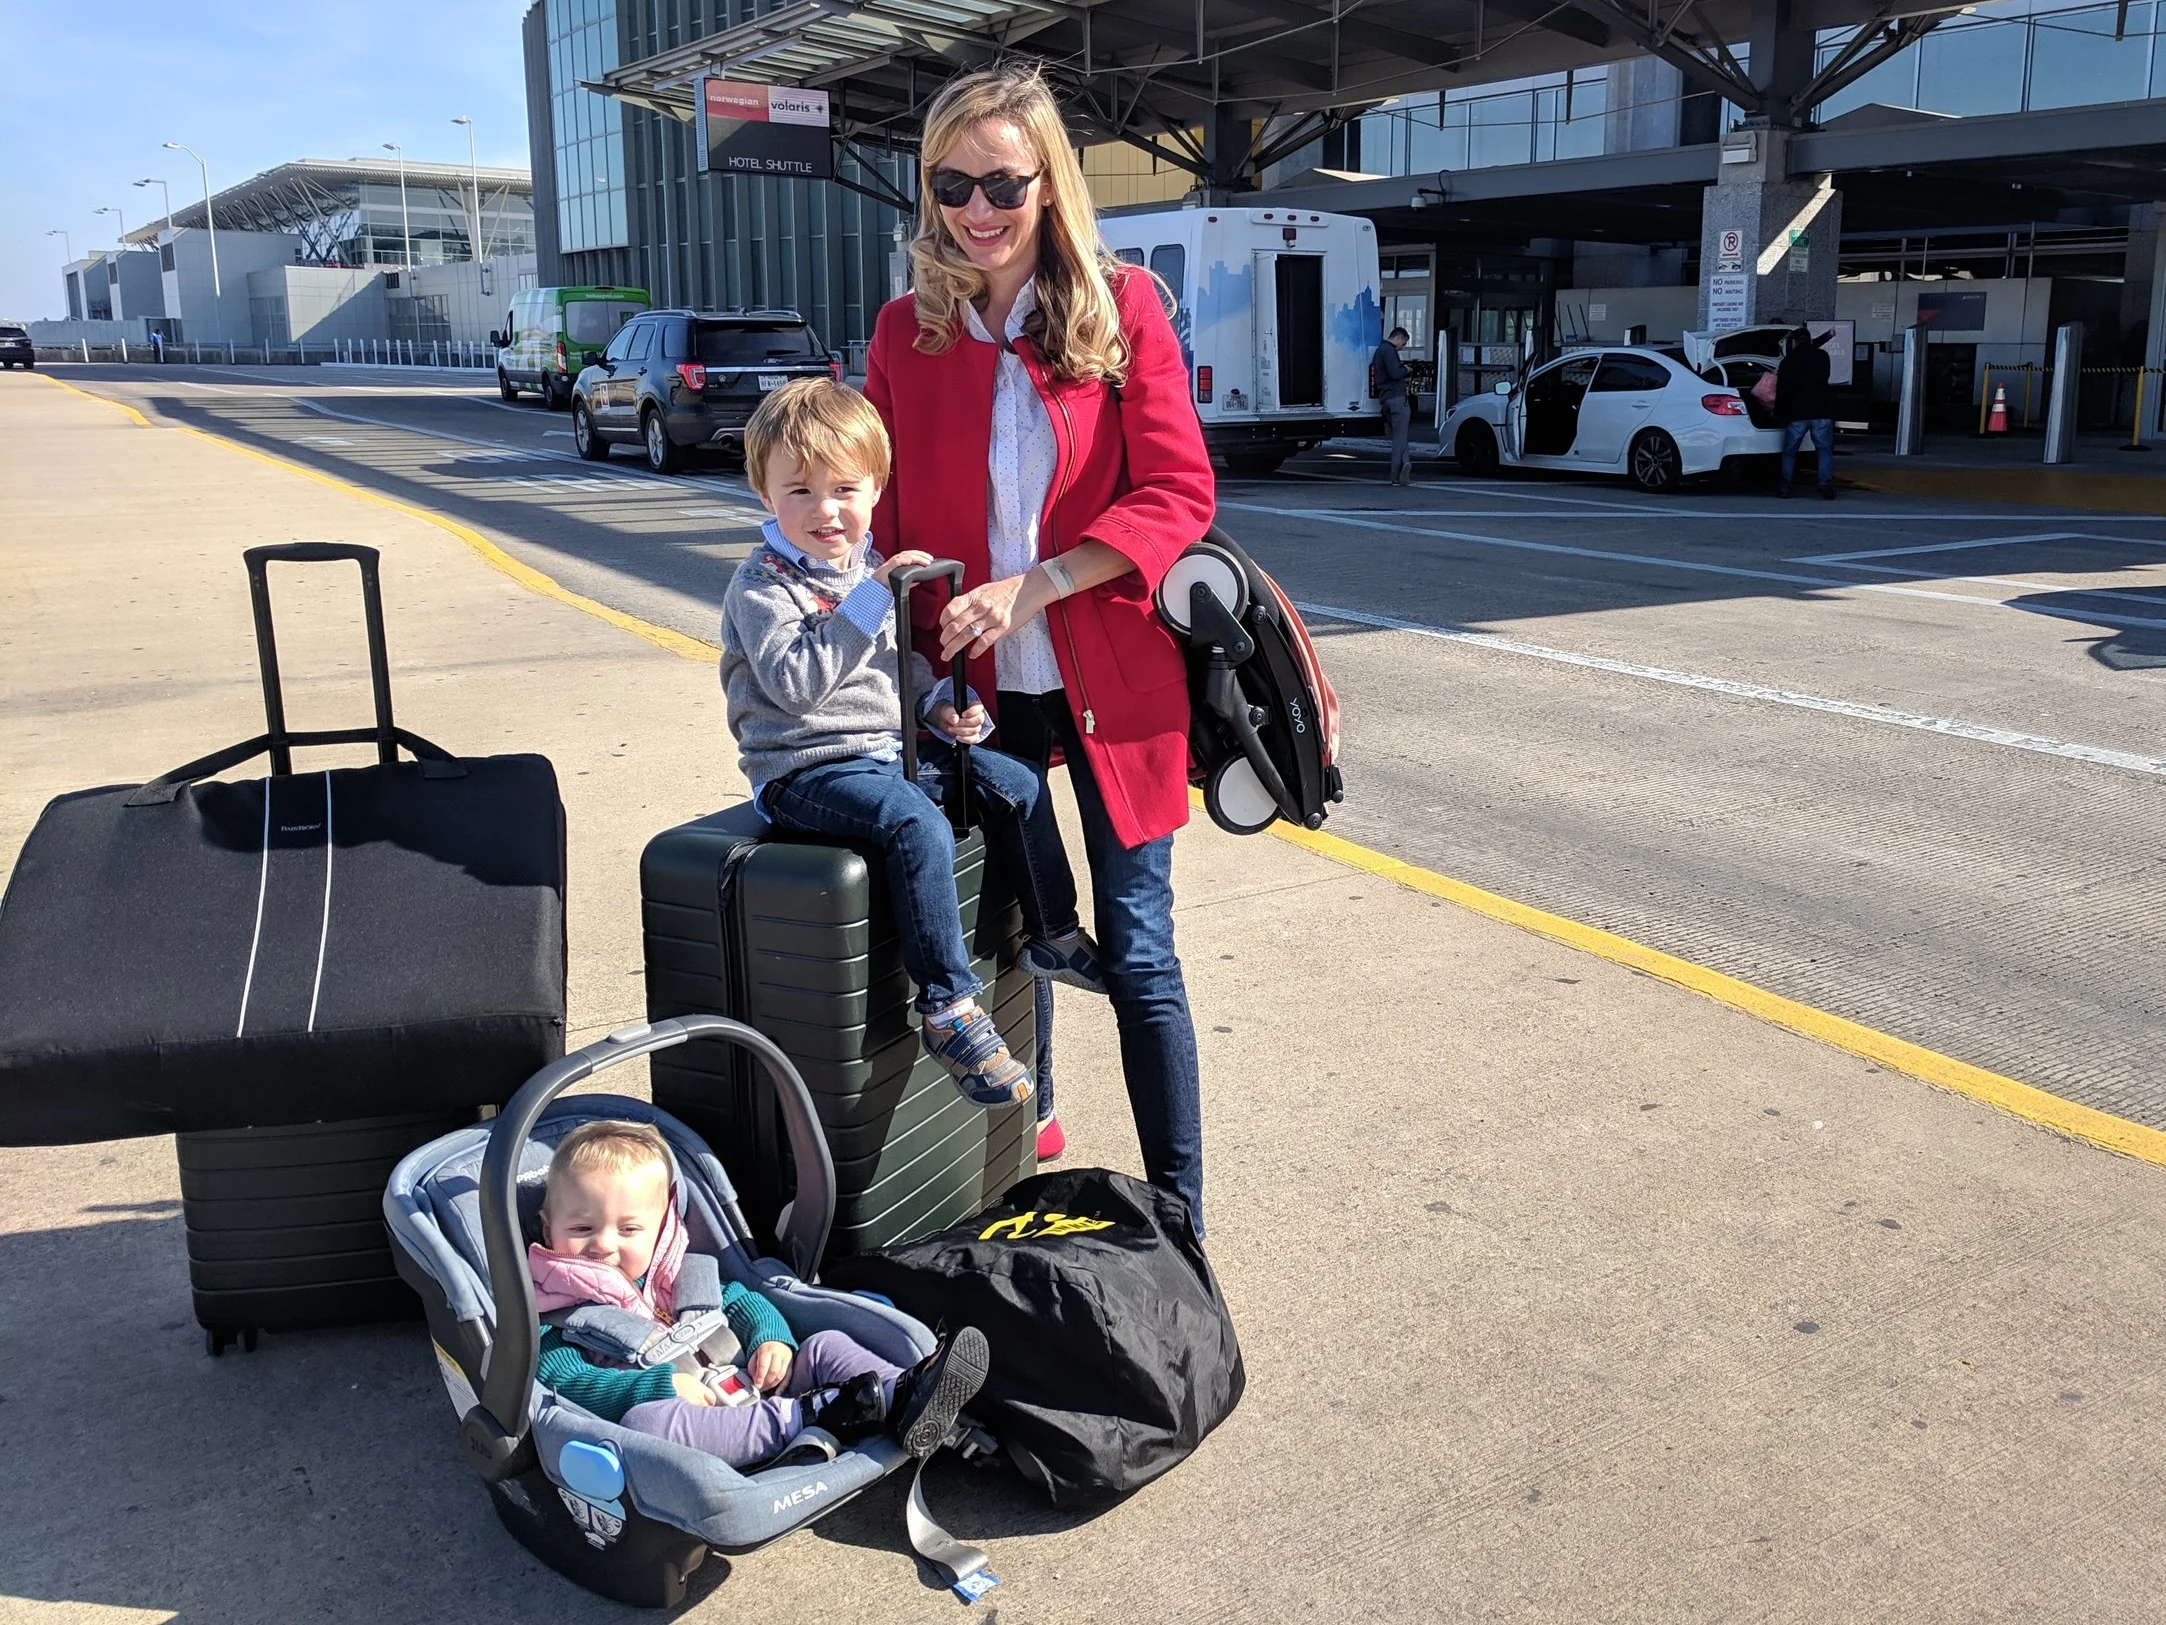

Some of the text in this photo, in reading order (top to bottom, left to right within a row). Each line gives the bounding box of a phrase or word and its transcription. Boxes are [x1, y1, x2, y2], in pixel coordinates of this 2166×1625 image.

[710, 95, 759, 106] norwegian
[771, 101, 810, 113] volaris
[729, 157, 812, 173] HOTEL SHUTTLE
[1712, 278, 1723, 286] NO
[1712, 287, 1723, 295] NO
[773, 1481, 829, 1514] MESA
